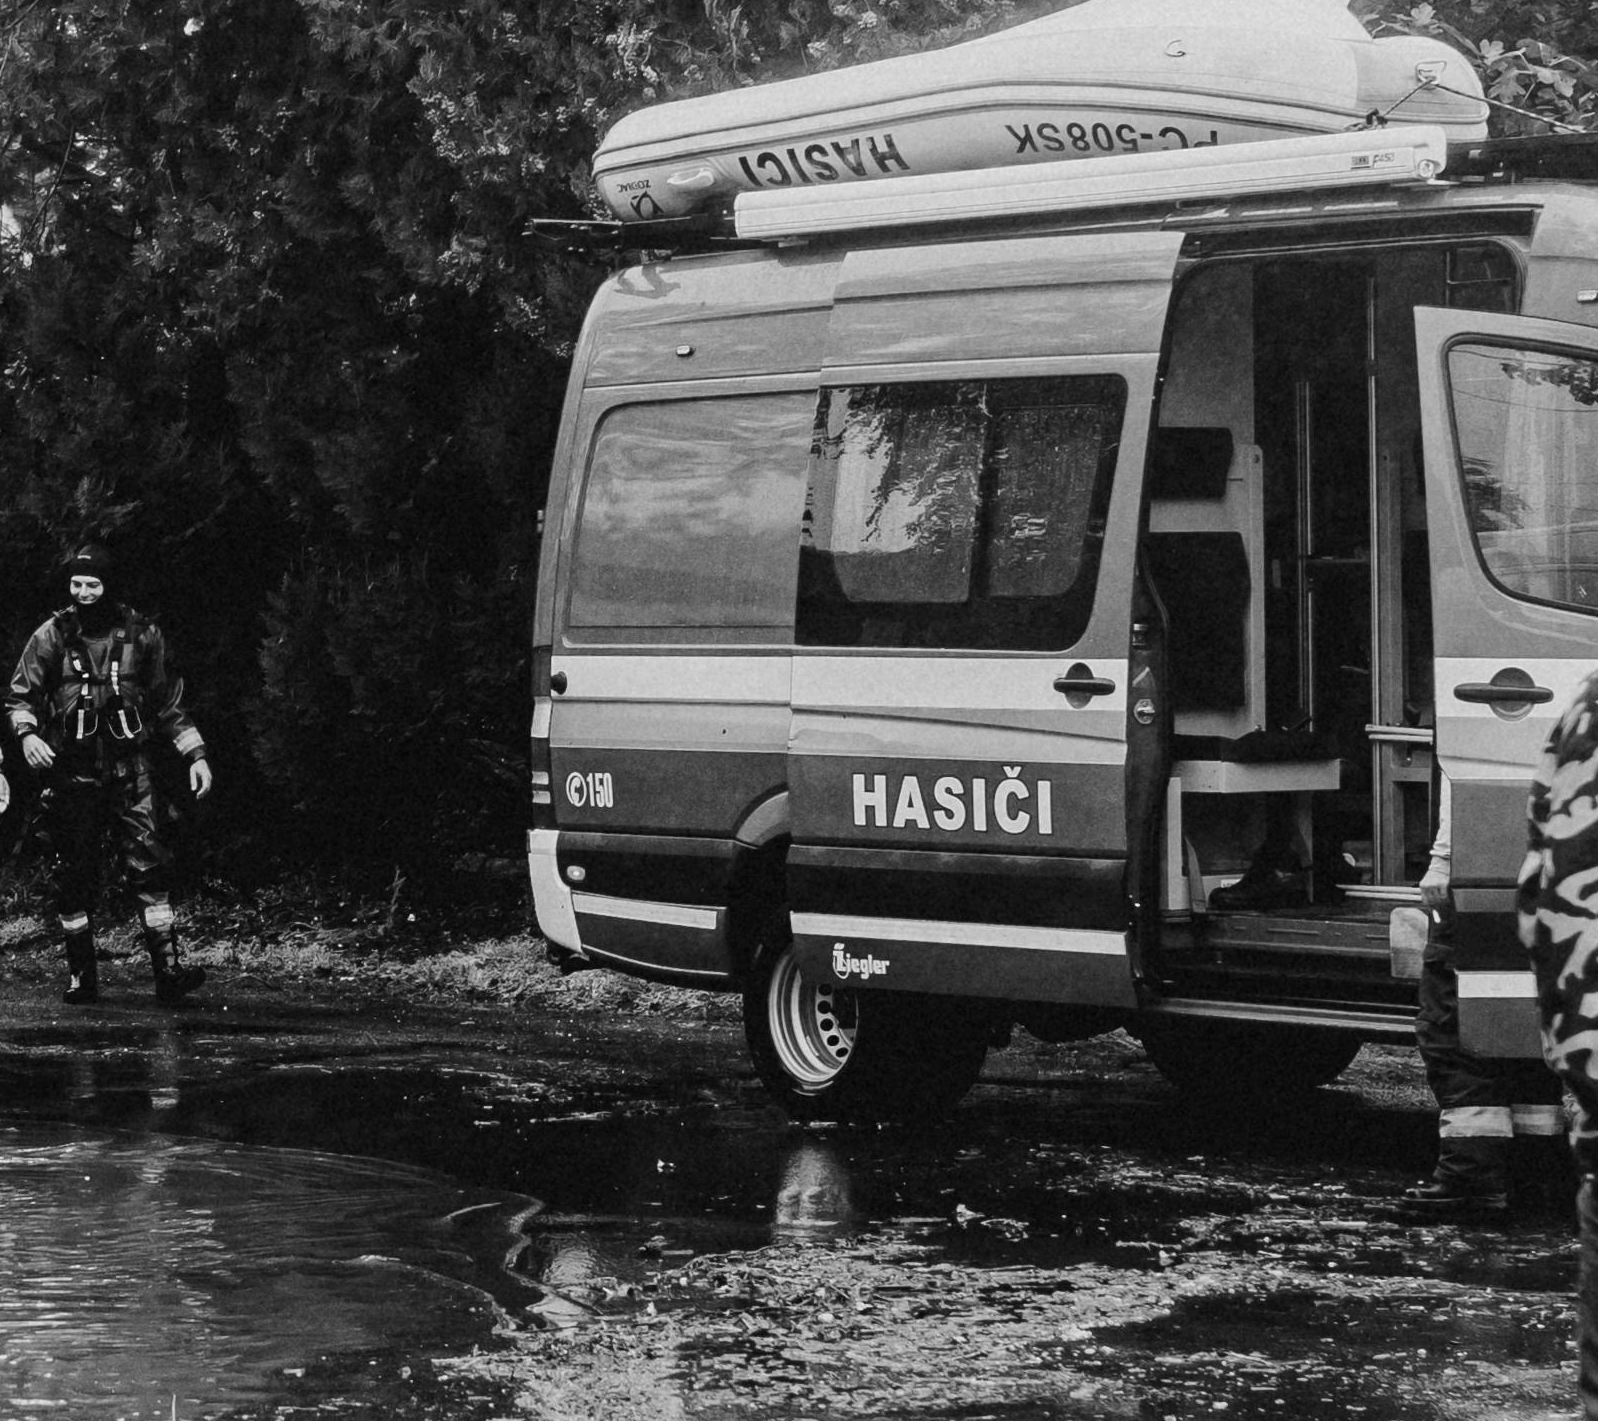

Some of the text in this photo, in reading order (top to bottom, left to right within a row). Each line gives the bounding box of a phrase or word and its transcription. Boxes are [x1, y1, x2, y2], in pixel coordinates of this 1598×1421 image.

[616, 180, 651, 193] ZODIAC
[586, 772, 614, 808] 150
[852, 766, 1053, 835] HASIČI
